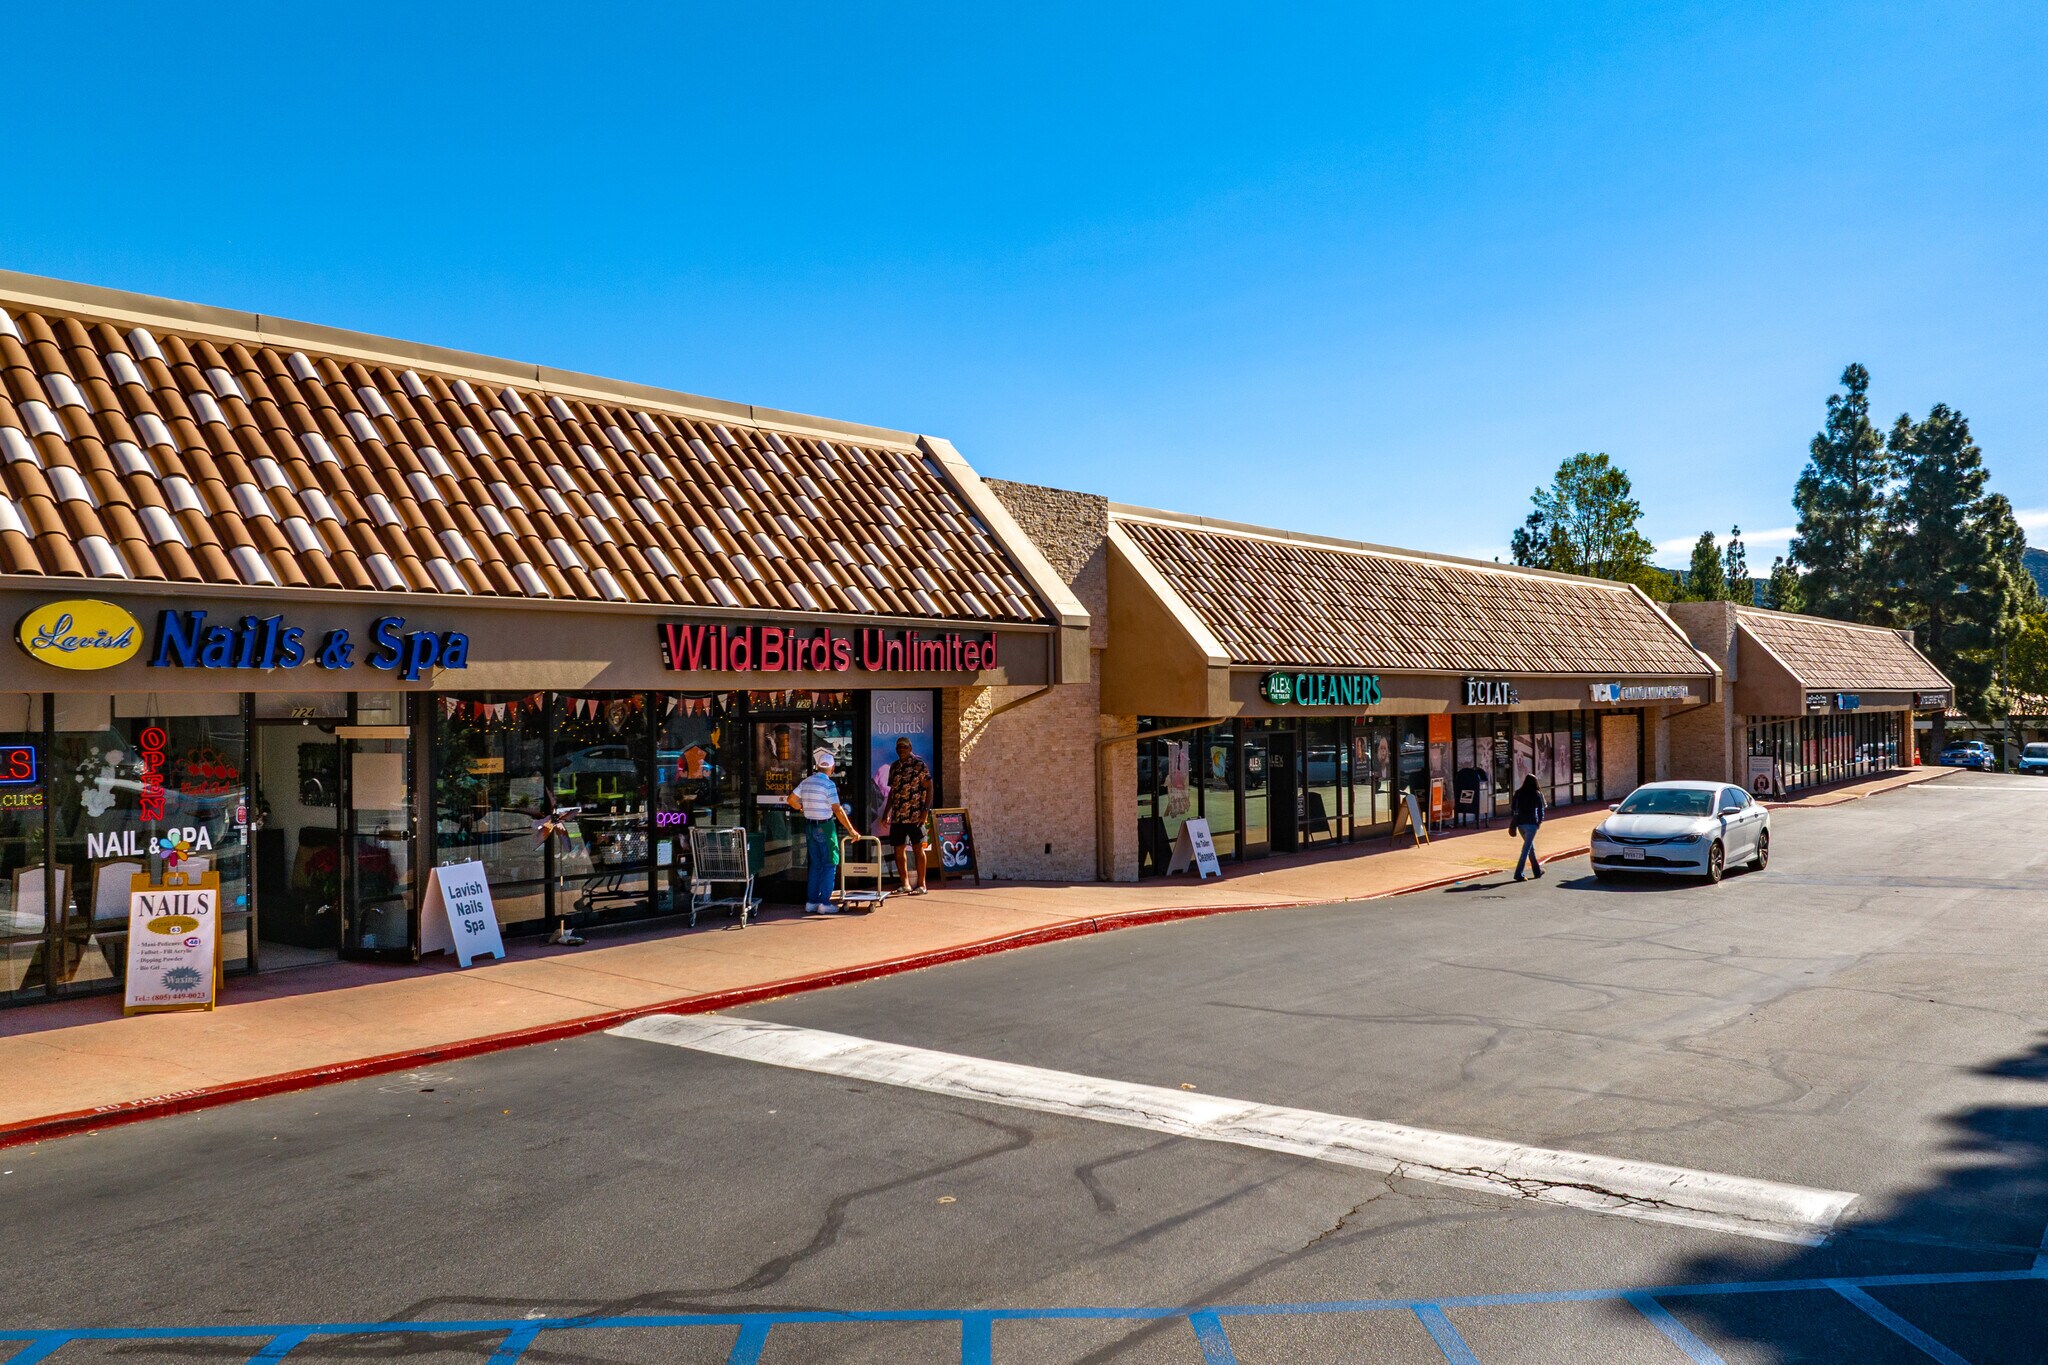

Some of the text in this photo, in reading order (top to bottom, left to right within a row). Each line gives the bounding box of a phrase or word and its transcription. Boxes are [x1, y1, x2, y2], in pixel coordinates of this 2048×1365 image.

[31, 613, 135, 653] Lavish
[149, 610, 470, 682] Nails & Spa
[662, 623, 998, 672] Wild Birds Unlimited
[1270, 677, 1291, 693] ALEX
[1296, 673, 1382, 706] CLEANERS
[1467, 676, 1510, 706] ÉCLAT
[292, 708, 316, 718] 724
[875, 696, 927, 714] Get close
[877, 716, 925, 735] to birds!
[140, 727, 166, 822] OPEN
[656, 812, 687, 827] open
[87, 830, 144, 859] NAIL
[149, 836, 161, 855] &
[448, 880, 483, 900] Lavish
[138, 892, 210, 917] NAILS
[456, 900, 484, 917] Nails
[464, 919, 486, 936] Spa
[166, 975, 199, 985] Waxing
[94, 1088, 206, 1113] NO PARKING
